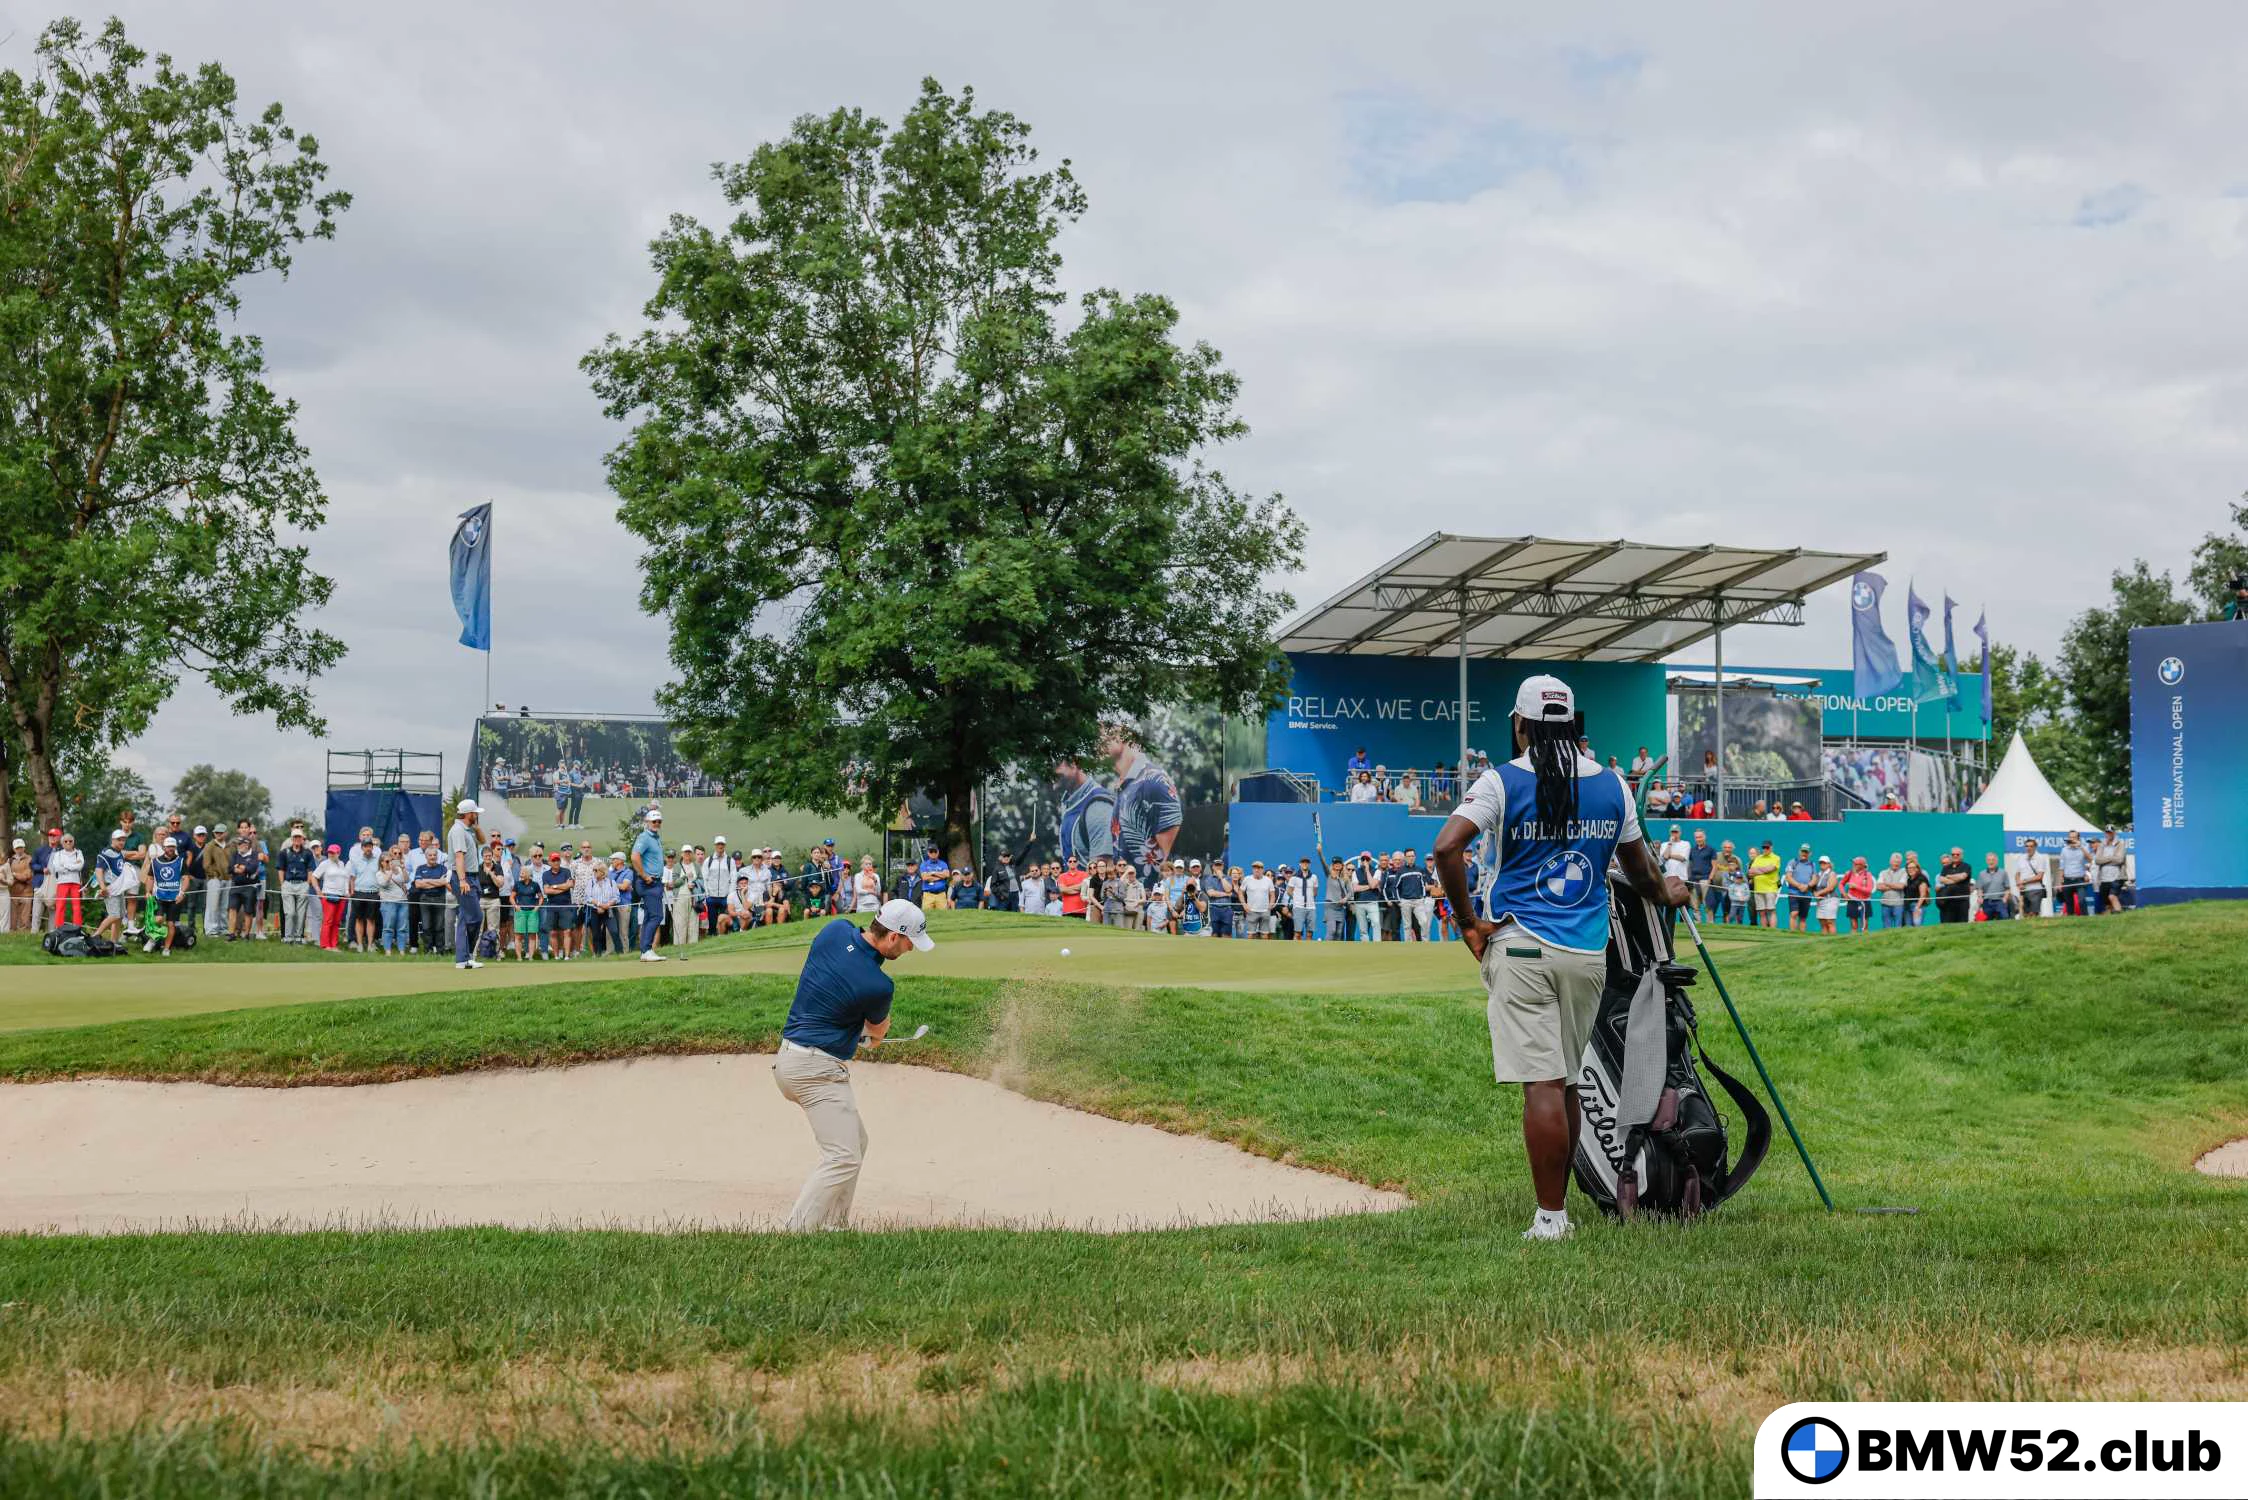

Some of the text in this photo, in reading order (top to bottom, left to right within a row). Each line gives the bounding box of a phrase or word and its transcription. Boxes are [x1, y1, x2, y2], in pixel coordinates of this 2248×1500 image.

[1288, 696, 1370, 719] RELAX.
[1376, 698, 1412, 720] WE
[1874, 696, 1919, 712] OPEN
[1288, 721, 1339, 730] BMW Service.
[2172, 695, 2185, 828] INTERNATIONAL OPEN
[2162, 797, 2173, 828] BMW
[1546, 853, 1588, 871] BMW
[1577, 1066, 1624, 1176] Titleis
